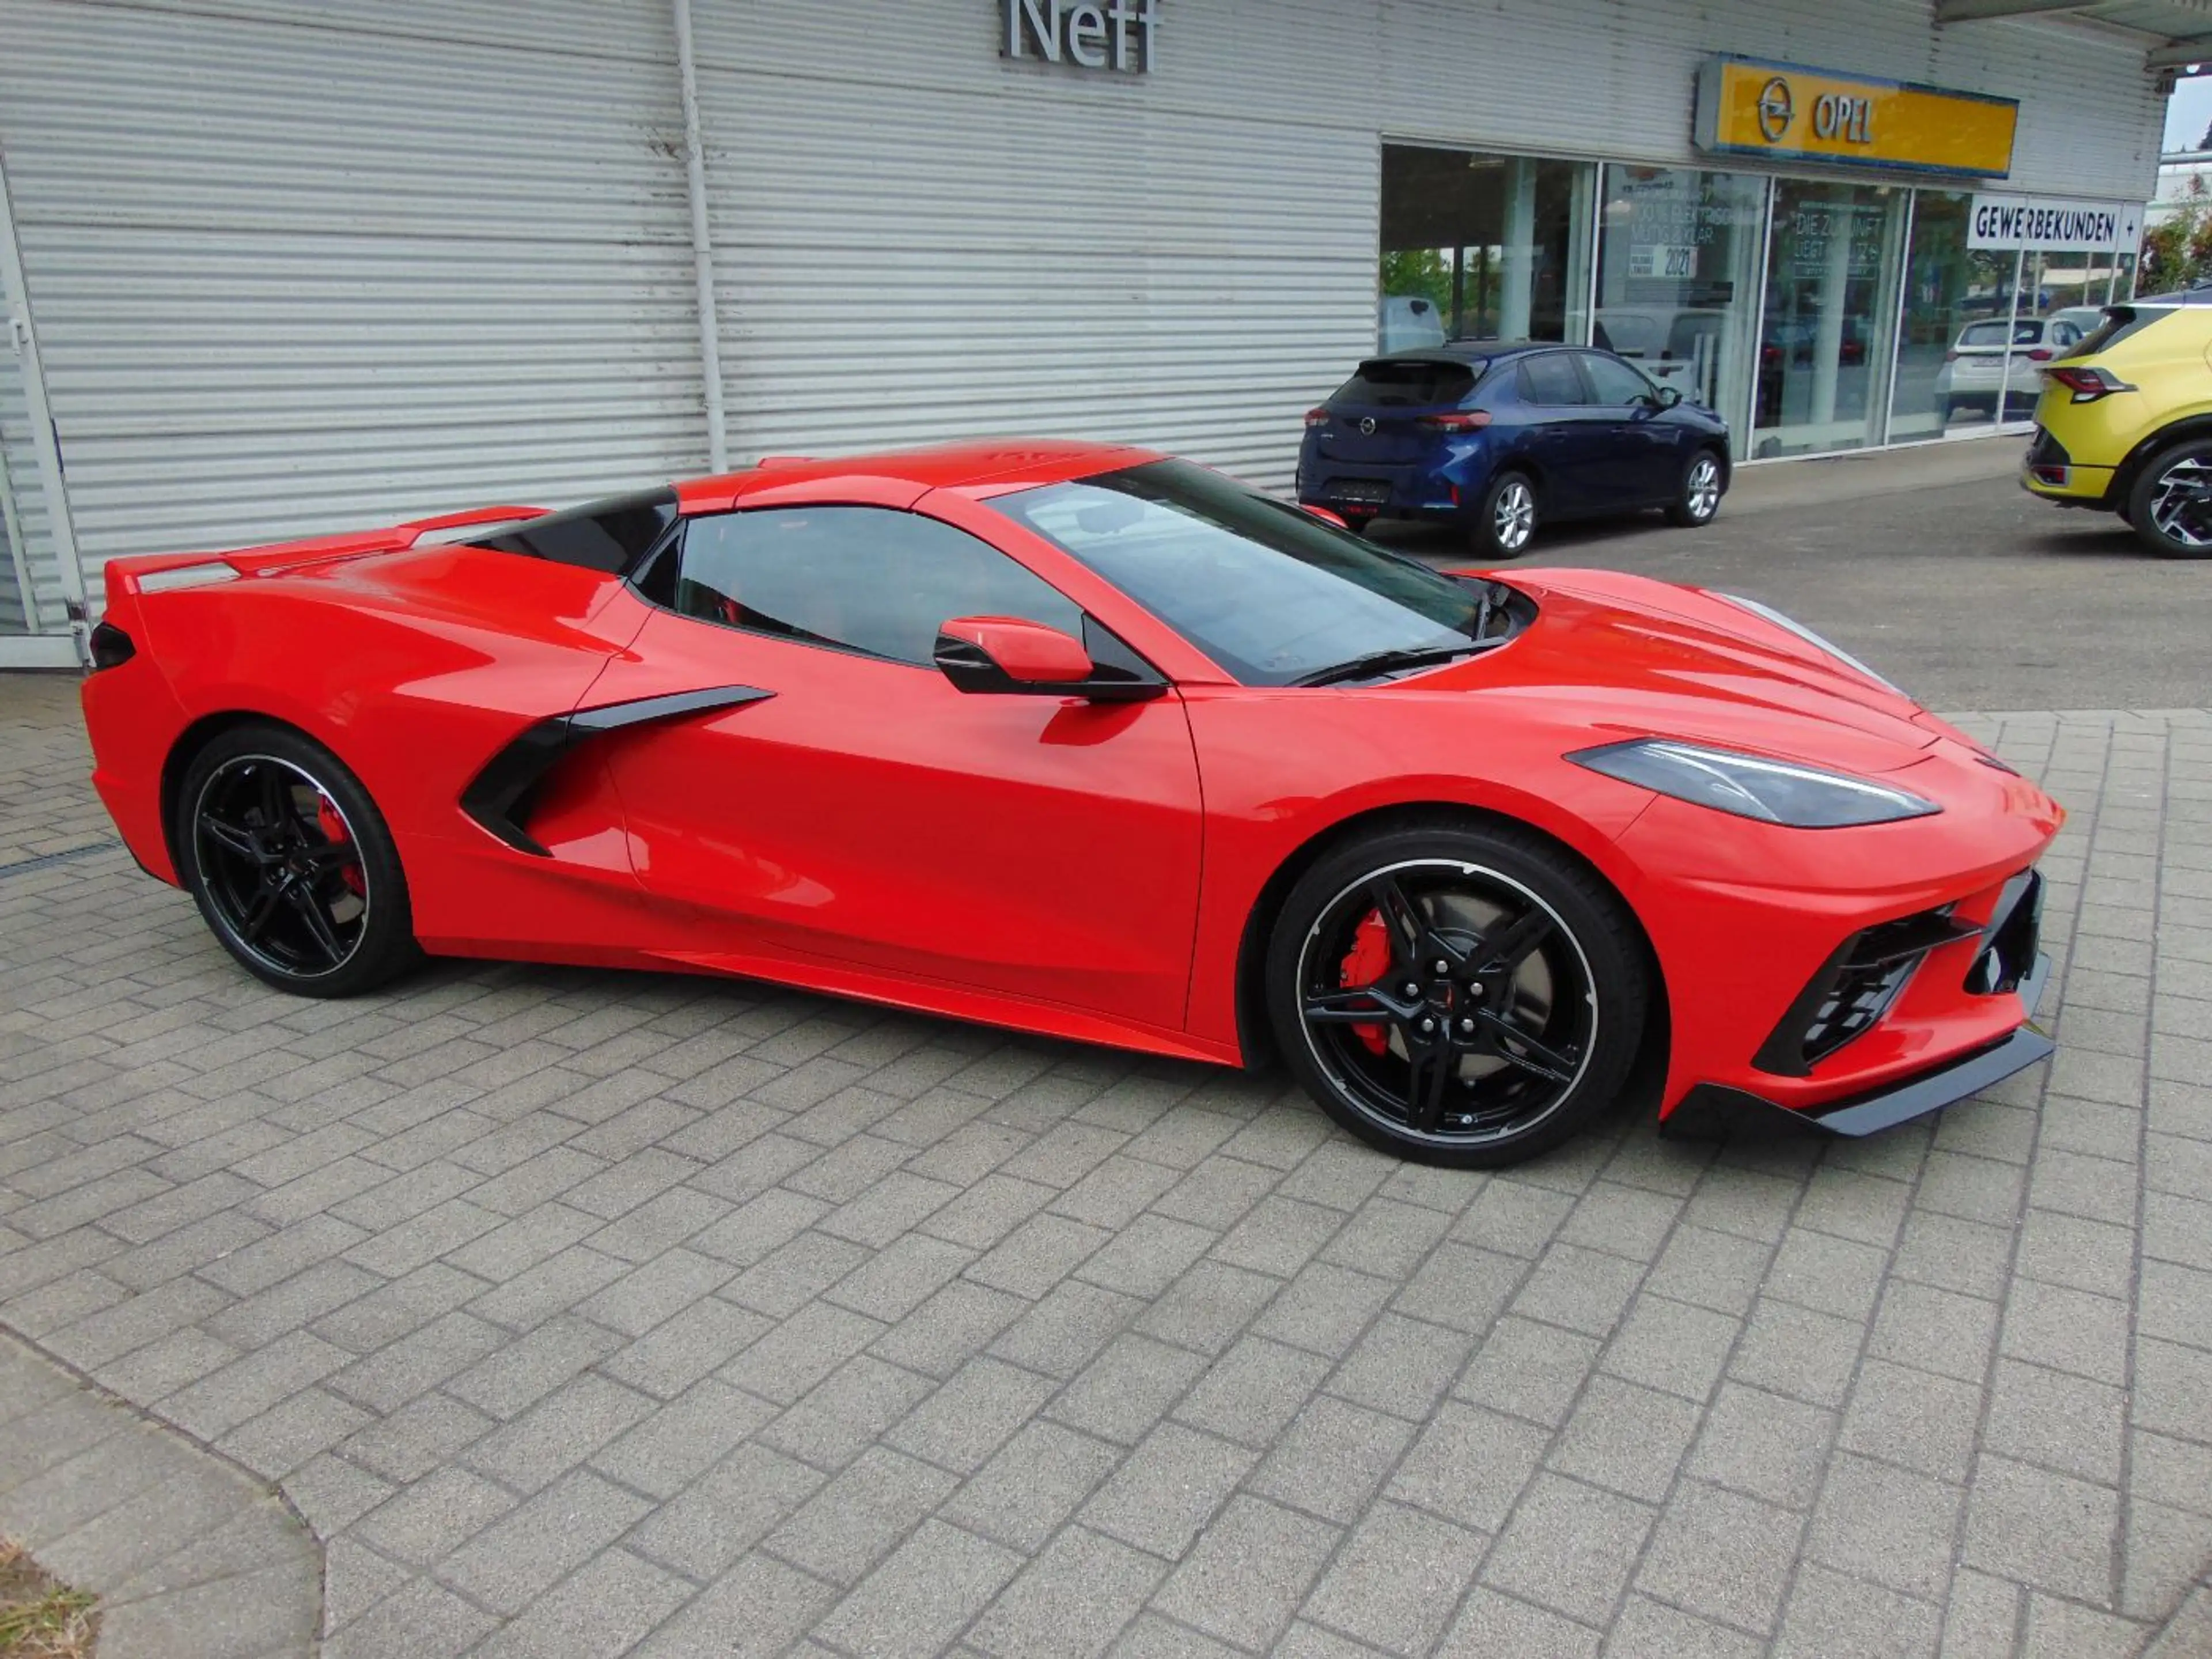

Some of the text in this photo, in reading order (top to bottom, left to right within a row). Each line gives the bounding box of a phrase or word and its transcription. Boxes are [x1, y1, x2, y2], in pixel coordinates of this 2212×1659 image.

[1000, 0, 1164, 74] Neff
[1813, 94, 1872, 144] OPEL
[1976, 205, 2115, 242] GEWERBEKUNDEN
